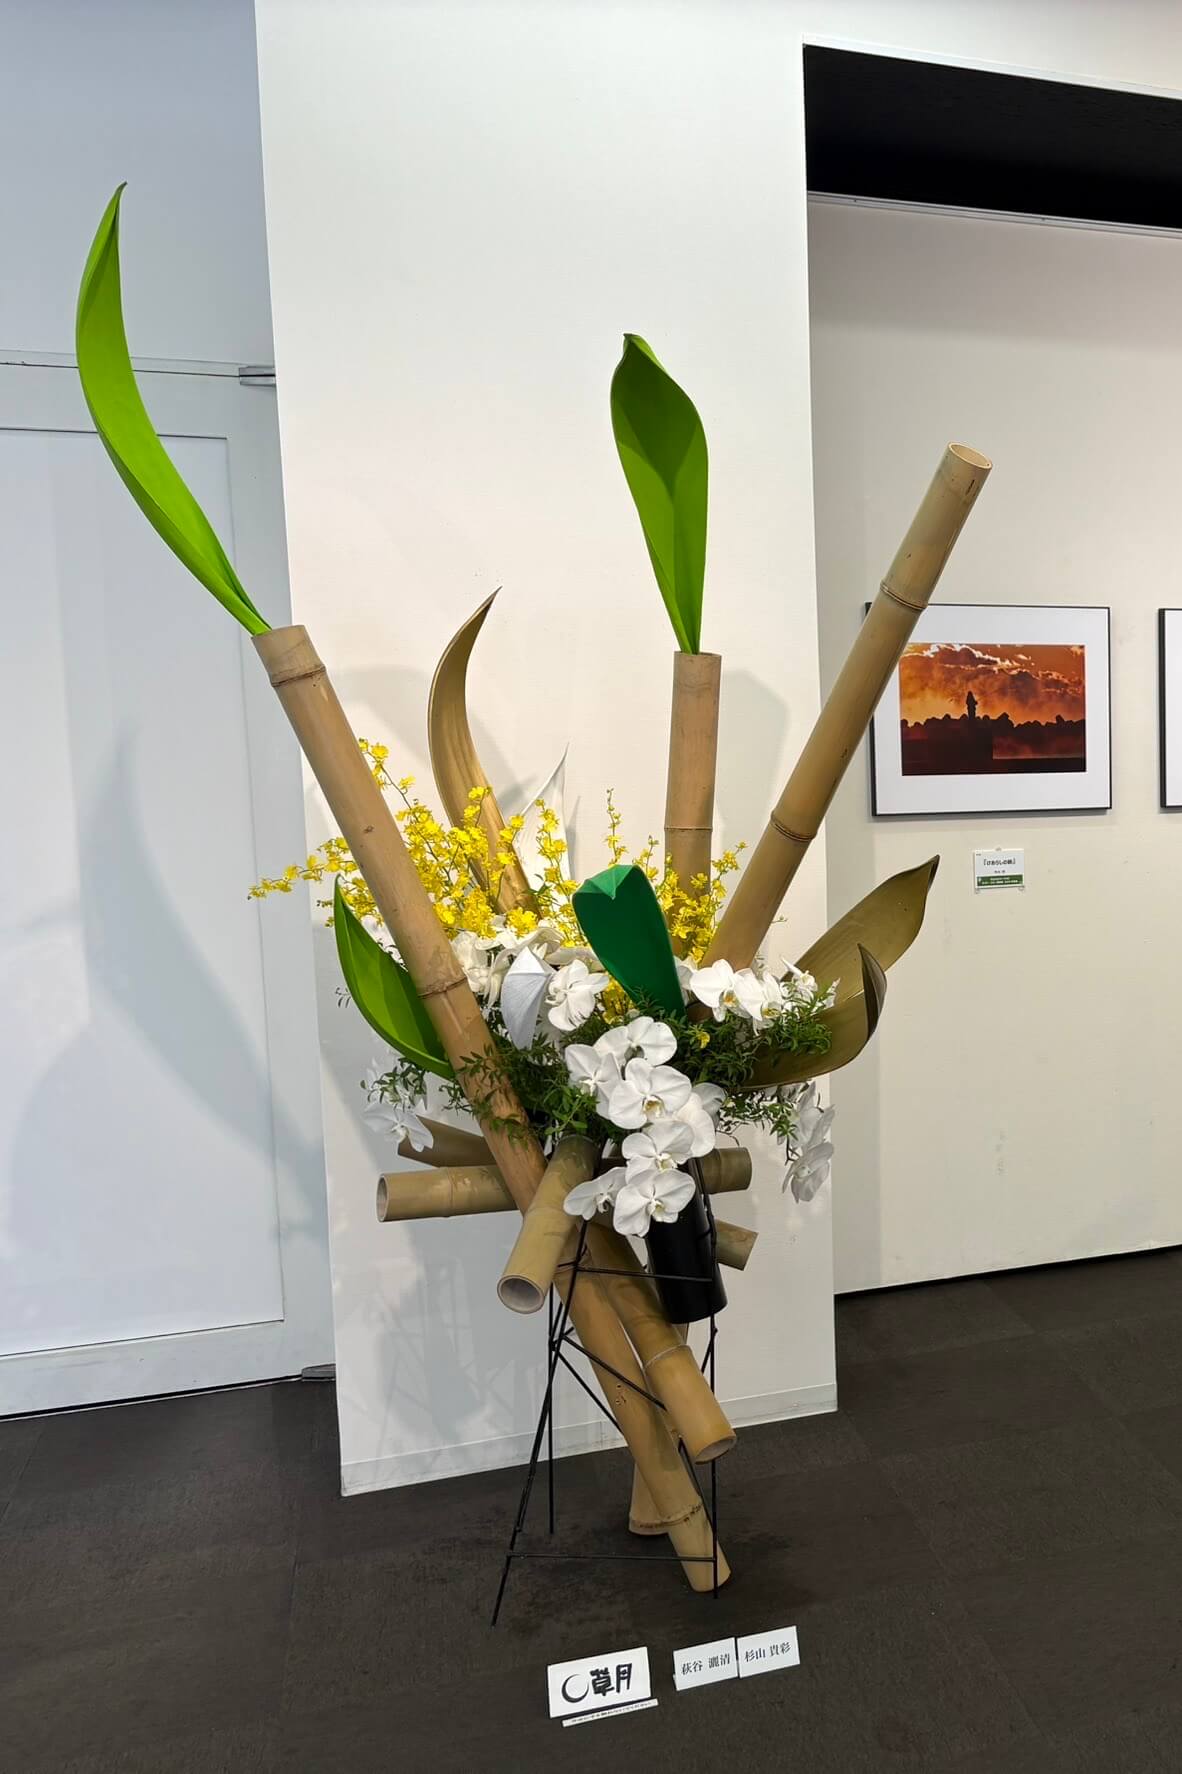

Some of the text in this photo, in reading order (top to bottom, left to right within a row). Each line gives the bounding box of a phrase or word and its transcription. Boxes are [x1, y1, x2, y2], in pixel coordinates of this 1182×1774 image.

[744, 1642, 792, 1663] 杉山 貴彩
[681, 1660, 703, 1675] 萩谷
[589, 1663, 633, 1697] 草月
